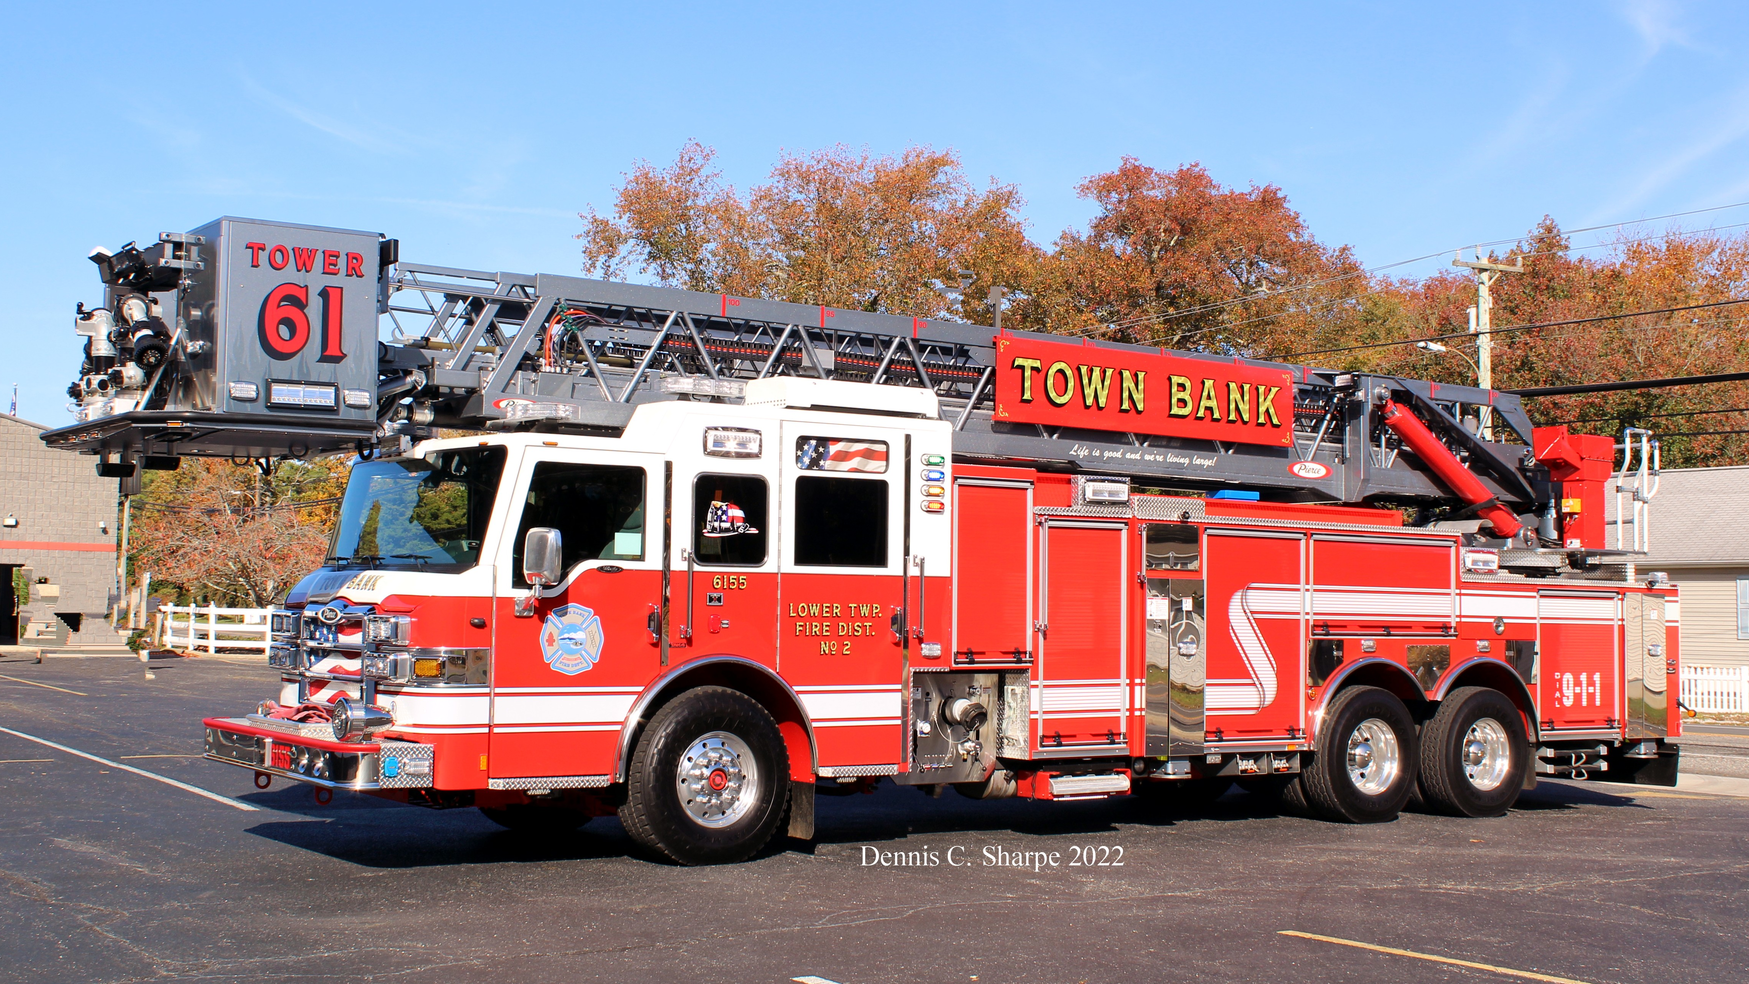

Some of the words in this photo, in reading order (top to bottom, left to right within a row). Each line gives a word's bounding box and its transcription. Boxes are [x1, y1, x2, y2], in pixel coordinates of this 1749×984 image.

[245, 241, 365, 278] TOWER
[728, 298, 740, 307] 100
[826, 310, 835, 318] 95
[257, 282, 348, 364] 61
[1011, 357, 1148, 415] TOWN
[1168, 374, 1281, 428] BANK
[1069, 444, 1089, 459] Life
[1092, 448, 1100, 457] is
[1104, 449, 1123, 461] good
[1125, 451, 1142, 460] and
[1144, 451, 1164, 462] we're
[1167, 453, 1190, 467] living
[1193, 455, 1218, 468] large!
[1297, 463, 1321, 474] Pierce
[346, 573, 384, 591] BANK
[712, 575, 747, 590] 6155
[789, 603, 841, 618] LOWER
[848, 603, 882, 618] TWP.
[795, 622, 831, 637] FIRE
[838, 622, 876, 637] DIST.
[842, 641, 851, 656] 2
[1562, 672, 1601, 708] 9-1-1
